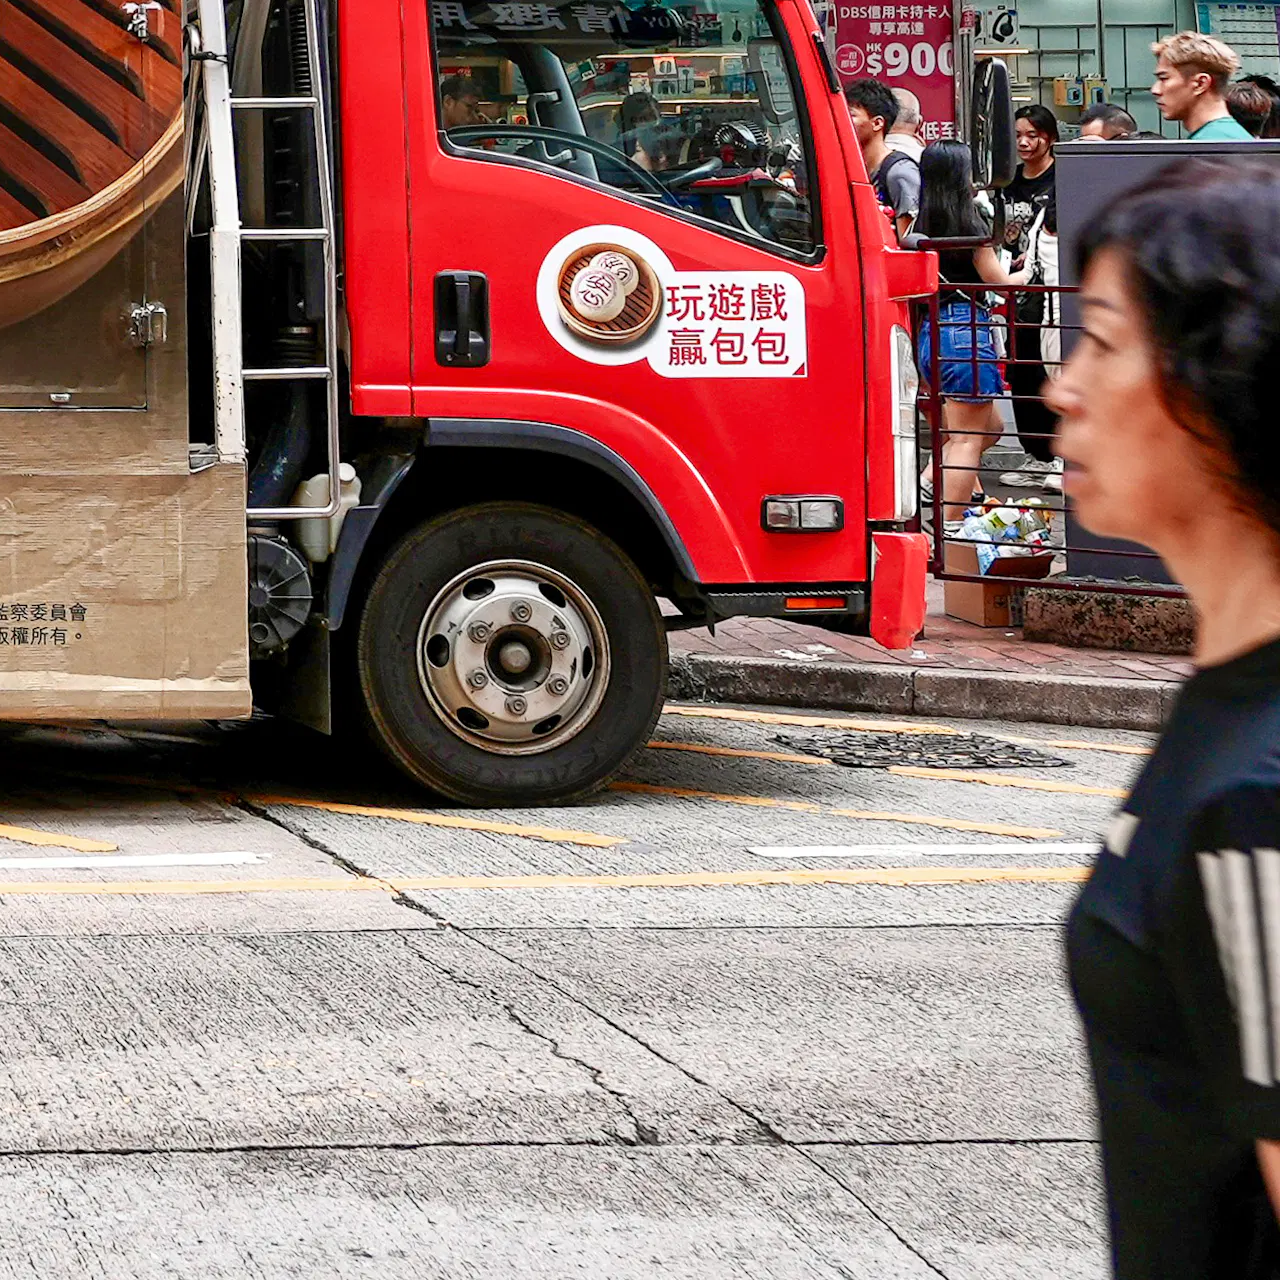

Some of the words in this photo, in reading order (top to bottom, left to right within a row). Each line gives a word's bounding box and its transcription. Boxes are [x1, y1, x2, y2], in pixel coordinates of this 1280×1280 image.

[840, 5, 951, 19] DBS信用卡持卡人
[869, 21, 924, 35] 專享高達
[666, 283, 789, 322] 玩遊戲
[667, 327, 790, 366] 贏包包
